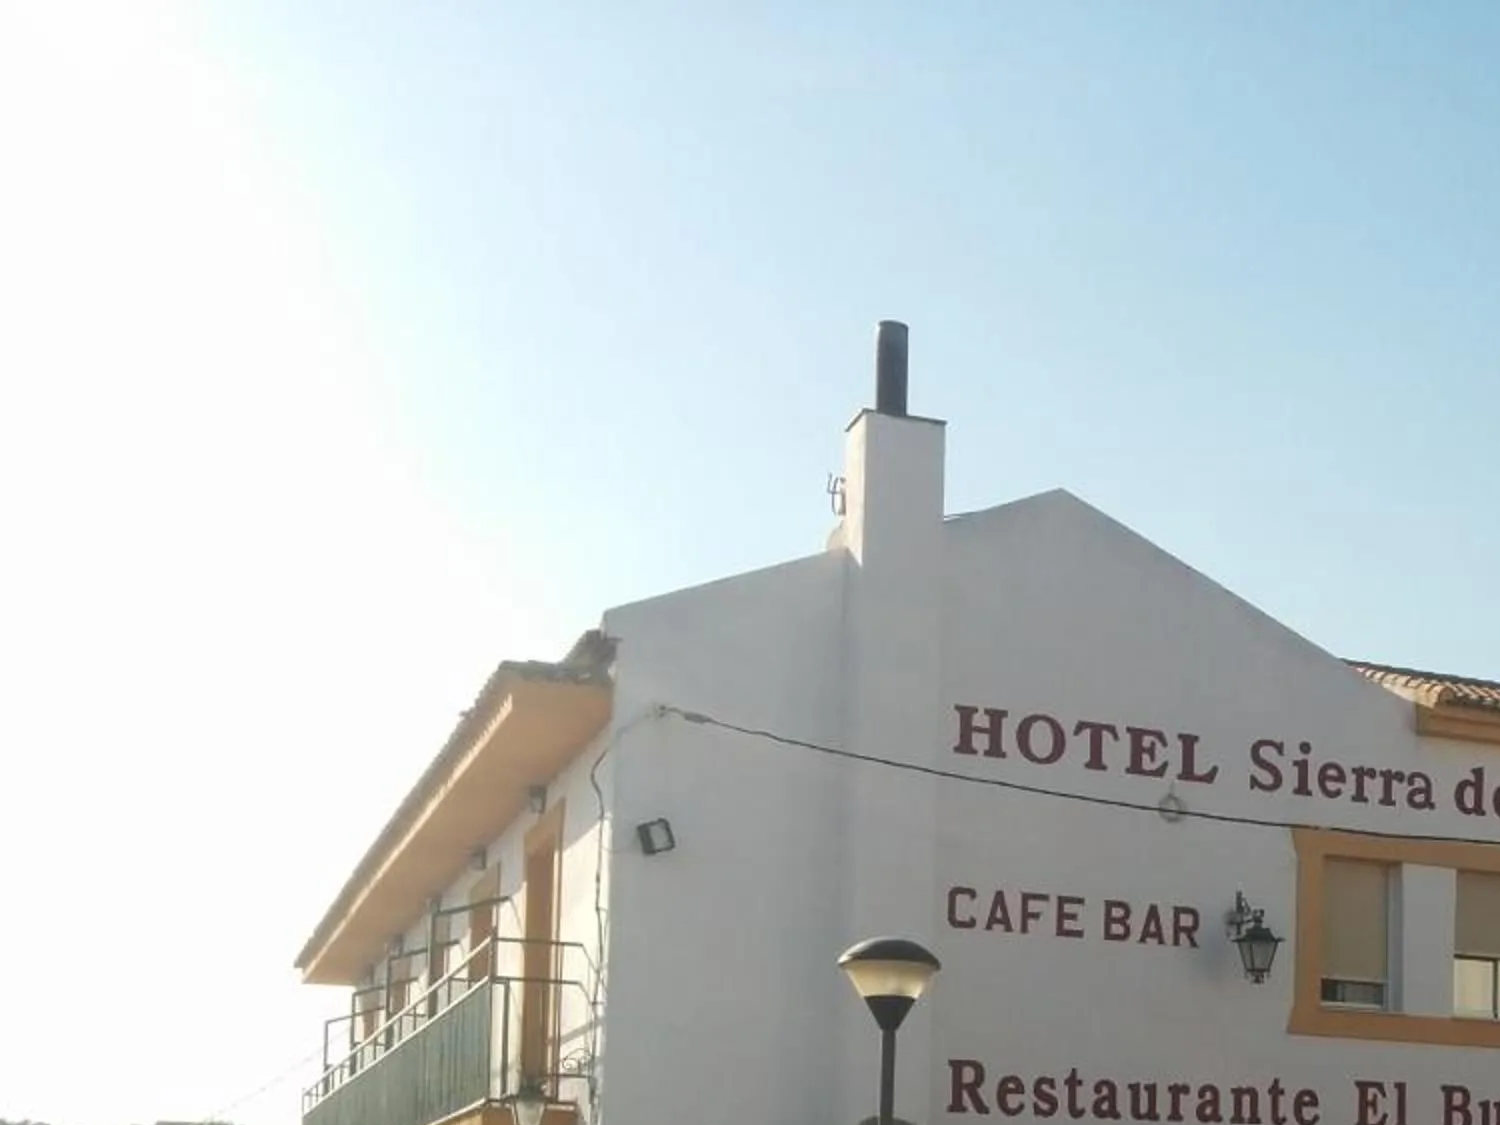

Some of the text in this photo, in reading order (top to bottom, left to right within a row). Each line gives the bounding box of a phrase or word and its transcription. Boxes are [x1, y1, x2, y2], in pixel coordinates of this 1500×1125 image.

[953, 704, 1219, 784] HOTEL
[1249, 739, 1435, 810] Sierra
[947, 886, 1200, 948] CAFE BAR
